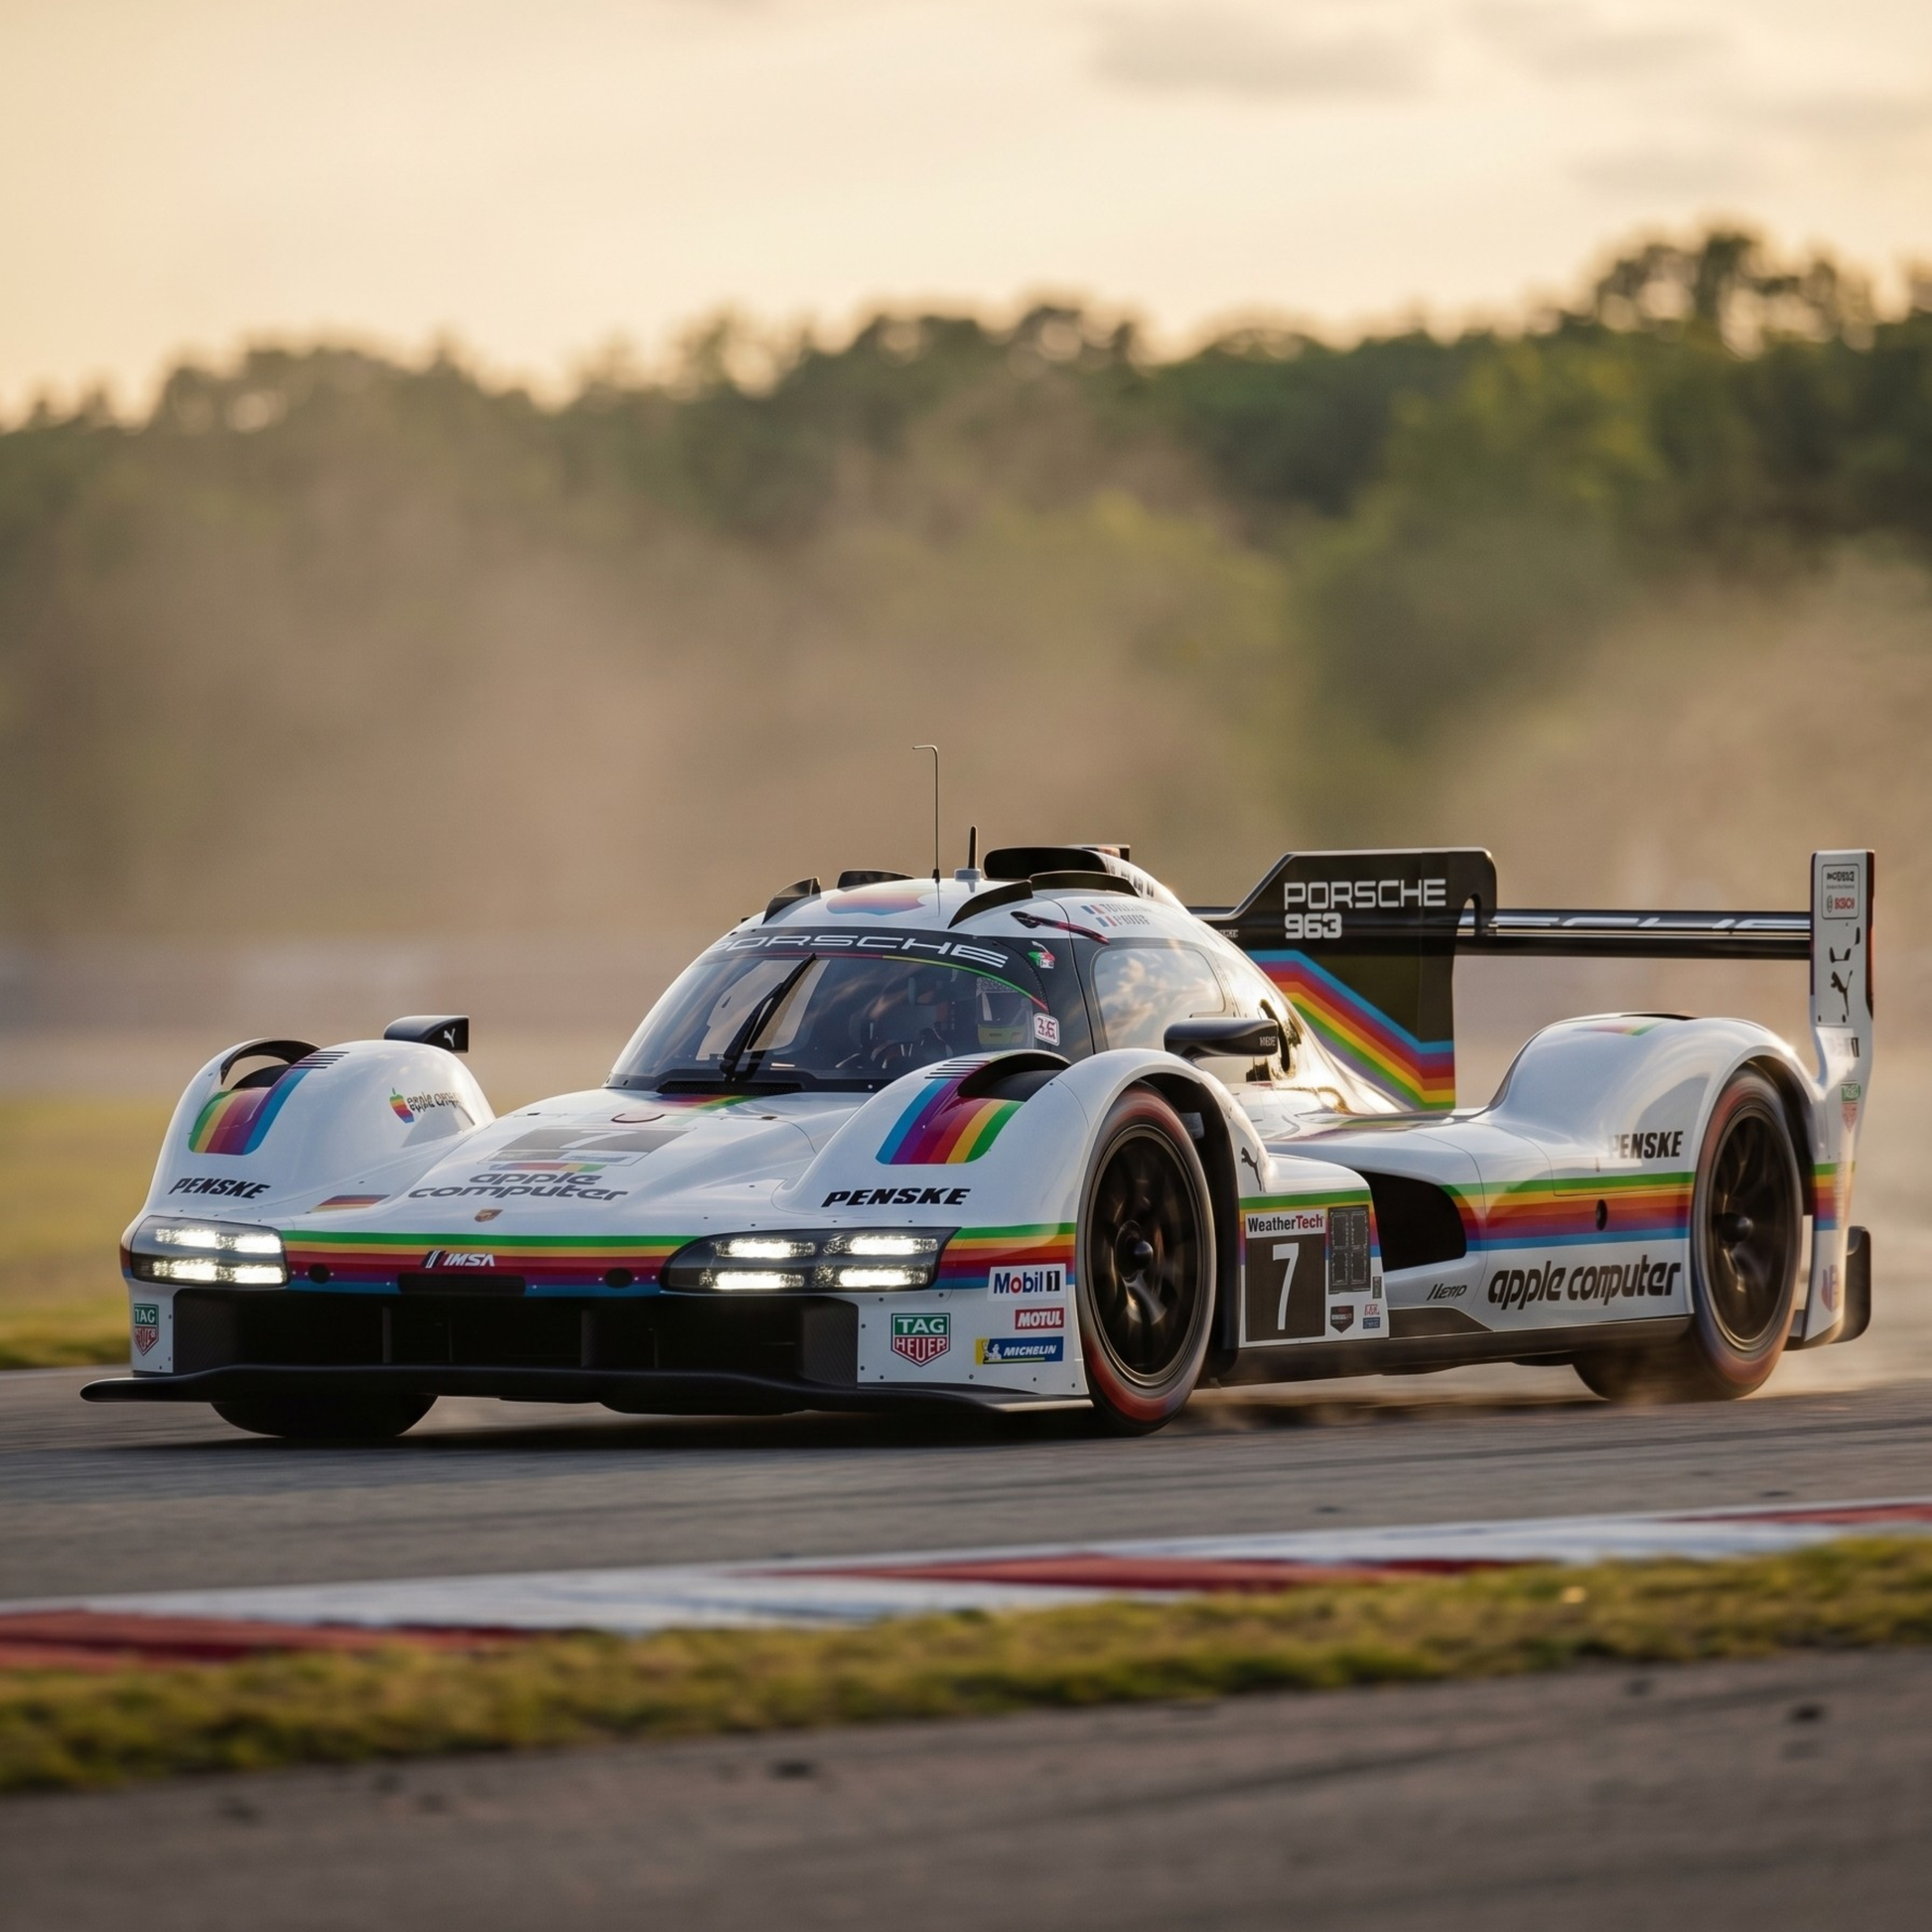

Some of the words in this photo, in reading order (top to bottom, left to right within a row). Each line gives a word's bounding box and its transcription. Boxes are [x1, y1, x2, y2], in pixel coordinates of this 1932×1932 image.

[1285, 879, 1447, 910] PORSCHE
[1285, 912, 1341, 939] 963
[707, 935, 1009, 968] PORSCHE
[559, 1131, 637, 1149] 7
[169, 1177, 271, 1199] PENSKE
[470, 1172, 603, 1185] apple
[408, 1185, 628, 1201] computer
[821, 1187, 971, 1207] PENSKE
[1247, 1213, 1323, 1233] WeatherTech
[443, 1253, 495, 1267] IMSA
[994, 1272, 1043, 1295] Mobil
[1272, 1242, 1300, 1330] 7
[1487, 1261, 1567, 1311] apple
[1568, 1255, 1682, 1307] computer
[897, 1318, 945, 1334] TAG
[1017, 1311, 1062, 1327] MOTUL
[896, 1338, 946, 1362] HEUER
[1003, 1345, 1057, 1357] MICHELIN
